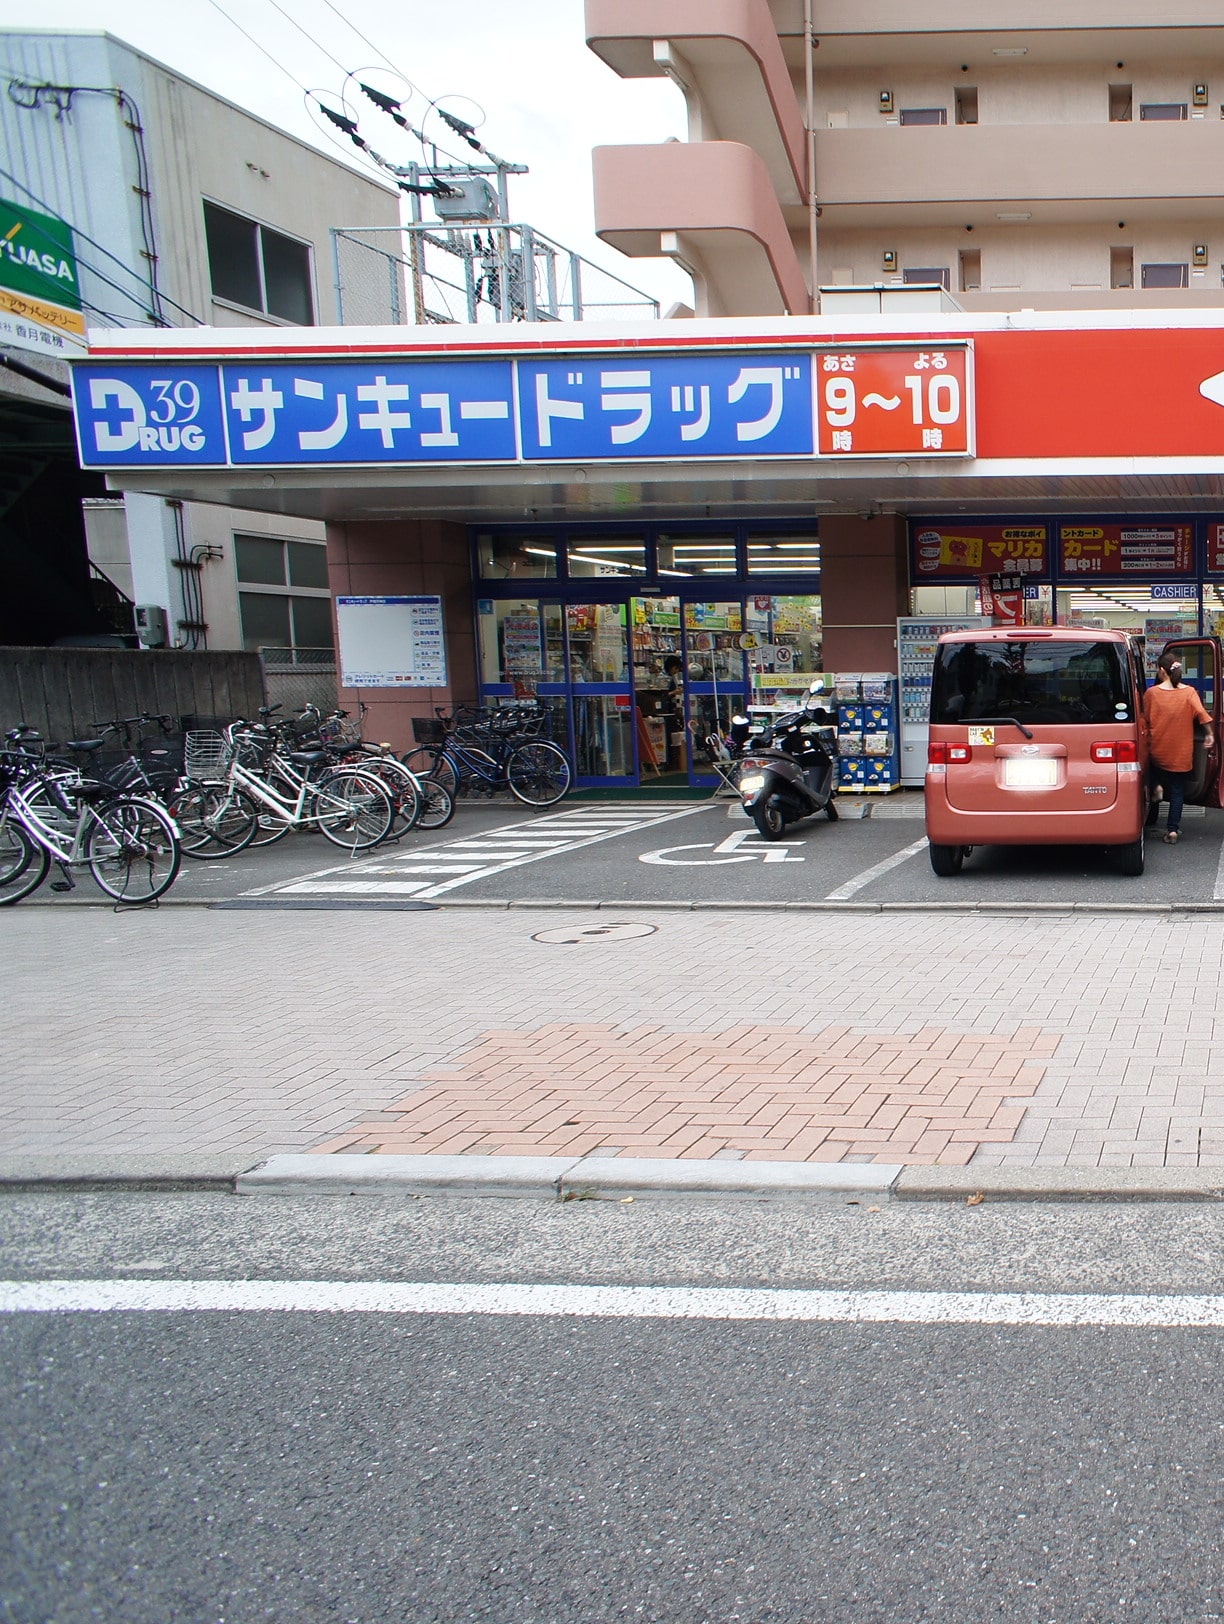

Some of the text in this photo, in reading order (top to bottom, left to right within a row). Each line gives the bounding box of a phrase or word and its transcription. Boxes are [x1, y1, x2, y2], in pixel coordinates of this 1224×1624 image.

[823, 352, 948, 372] あさ よる
[150, 379, 200, 424] 39
[832, 428, 943, 451] 時 時
[1153, 586, 1197, 598] CASHIER
[1082, 786, 1107, 794] TANTO
